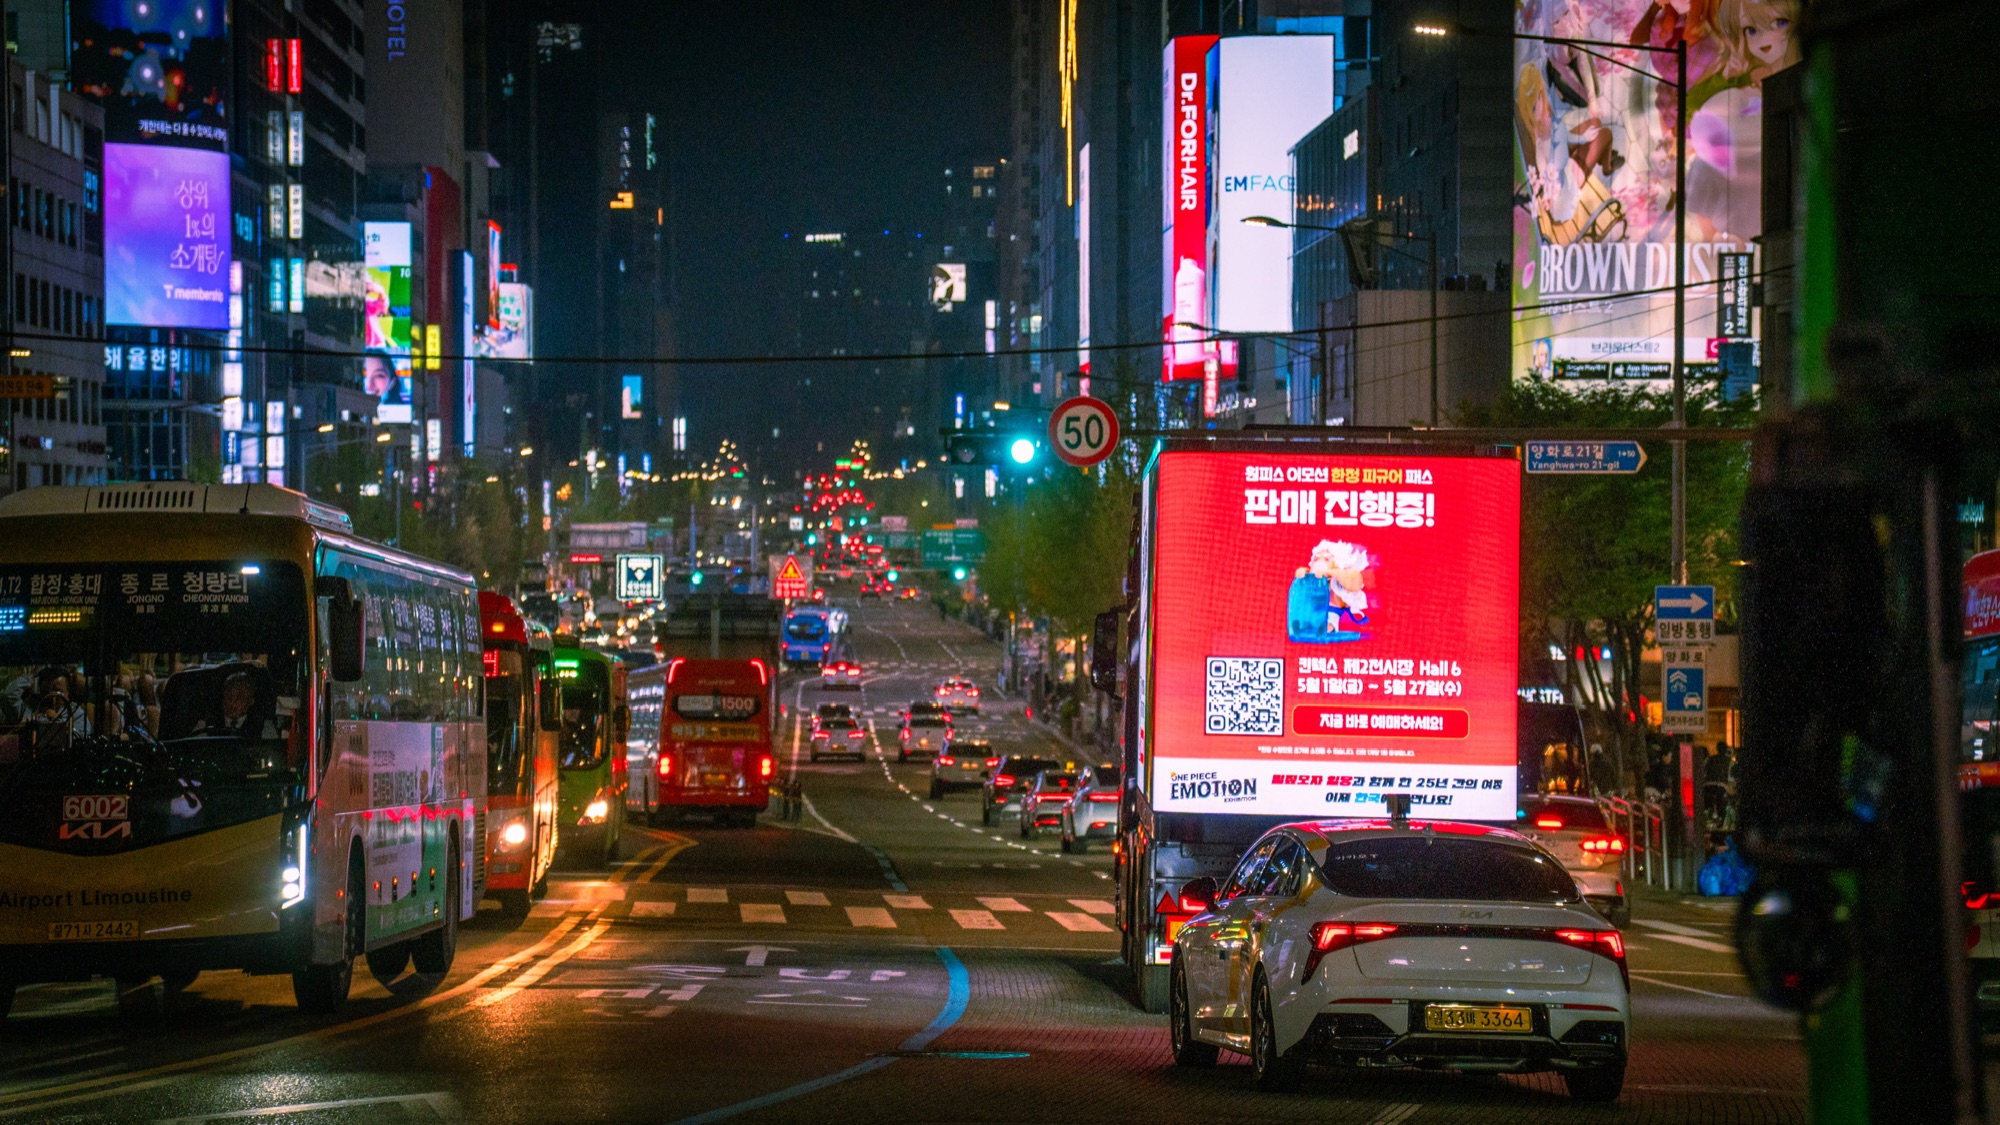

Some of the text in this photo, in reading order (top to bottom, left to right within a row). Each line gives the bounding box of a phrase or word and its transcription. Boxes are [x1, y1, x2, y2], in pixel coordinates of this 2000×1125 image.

[1180, 72, 1198, 211] Dr.FORHAIR
[175, 179, 208, 209] 상위
[185, 212, 215, 240] 1%의
[170, 243, 225, 275] 소개팅
[1539, 242, 1638, 294] BROWN
[163, 284, 174, 299] T
[1724, 321, 1735, 335] 2
[1064, 413, 1104, 450] 50
[1244, 466, 1433, 485] 원피스 이모션 한정 피규어 패스
[1531, 460, 1620, 472] Yanghwa-ro 21-gil
[1244, 489, 1435, 528] 판매 진행중!
[183, 571, 248, 593] 청량리
[127, 594, 165, 604] JONGNO
[183, 594, 249, 603] CHEONGNYANGNI
[1658, 620, 1711, 640] 일방통행
[1298, 657, 1462, 677] 킨텍스 제2전시장 Hall 6
[1666, 651, 1704, 663] 양화로
[1298, 677, 1320, 694] 5월
[1322, 678, 1364, 695] 1일(금)
[1384, 680, 1407, 696] 5월
[1408, 680, 1462, 697] 27일(수)
[721, 697, 755, 710] 1500
[1319, 713, 1444, 731] 지금 바로 예매하세요!
[1170, 772, 1218, 782] ONE PIECE
[1368, 777, 1394, 788] 함께
[1398, 777, 1411, 788] 한
[1415, 778, 1449, 789] 25년
[1451, 778, 1478, 789] 간의
[1481, 779, 1503, 790] 여정
[1169, 777, 1257, 801] EMOTION
[1325, 792, 1350, 803] 이제
[65, 797, 126, 819] 6002
[0, 887, 192, 911] Airport Limousine
[96, 921, 133, 937] 2442
[1480, 1011, 1524, 1028] 3364
